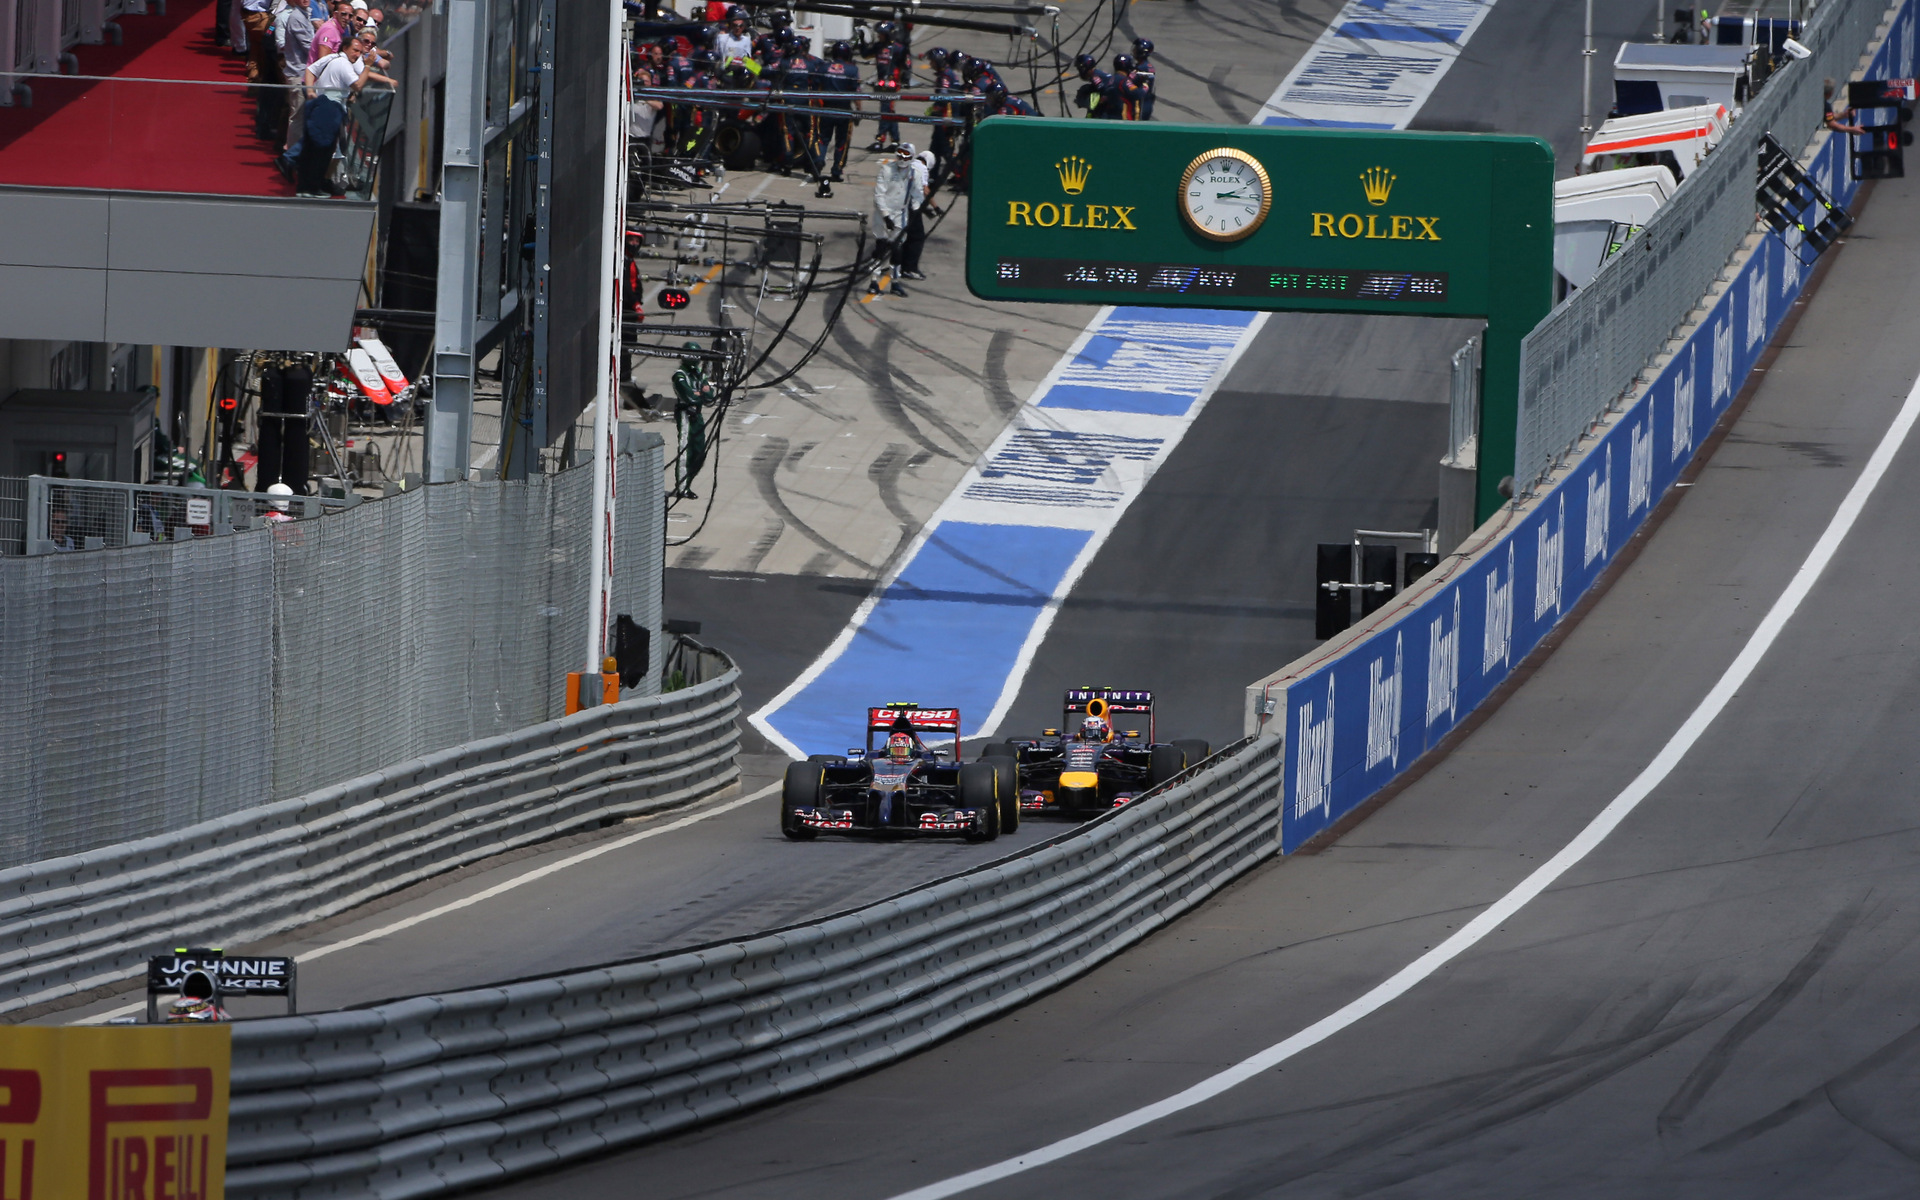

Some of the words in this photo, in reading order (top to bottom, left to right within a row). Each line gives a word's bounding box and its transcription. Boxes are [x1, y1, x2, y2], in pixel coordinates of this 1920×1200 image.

[1210, 176, 1240, 184] ROLEX
[1006, 201, 1137, 230] ROLEX
[1311, 212, 1442, 241] ROLEX
[1270, 273, 1300, 289] PIT
[1306, 275, 1349, 291] EXIT
[235, 504, 254, 512] TOR
[1295, 700, 1325, 820] Allianz
[165, 977, 281, 988] WKER
[89, 1067, 213, 1200] PIRELLI
